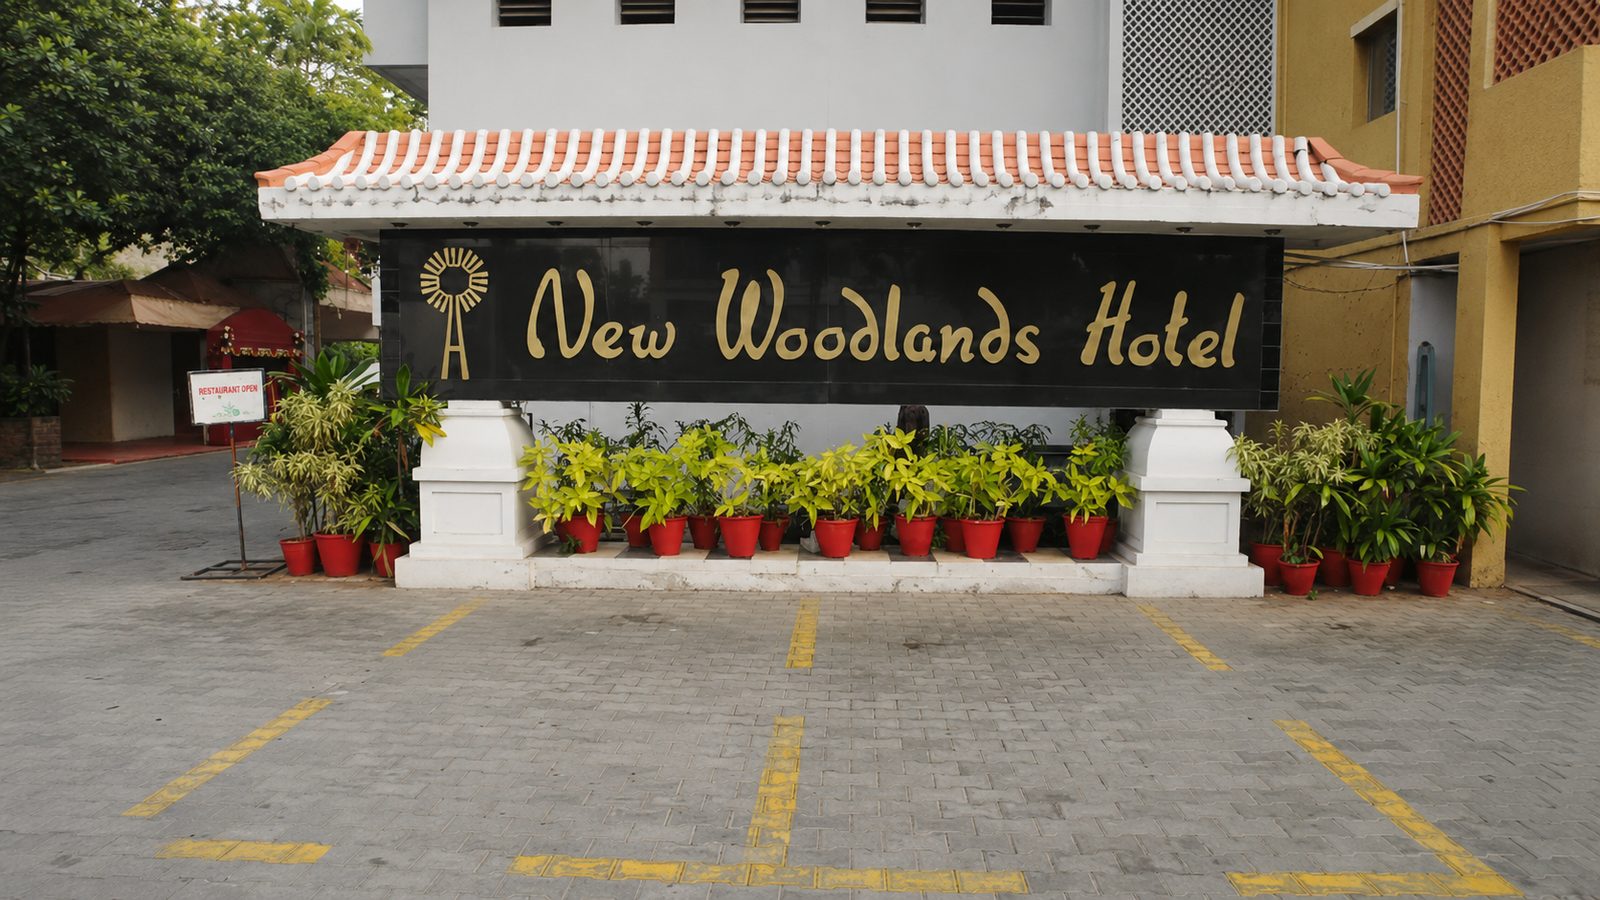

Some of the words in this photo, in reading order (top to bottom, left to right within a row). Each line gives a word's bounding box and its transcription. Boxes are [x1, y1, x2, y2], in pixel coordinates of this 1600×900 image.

[526, 268, 676, 359] New
[715, 268, 1040, 364] Woodlands
[1080, 280, 1245, 368] Hotel
[199, 385, 240, 395] RESTAURANT
[242, 384, 258, 393] OPEN
